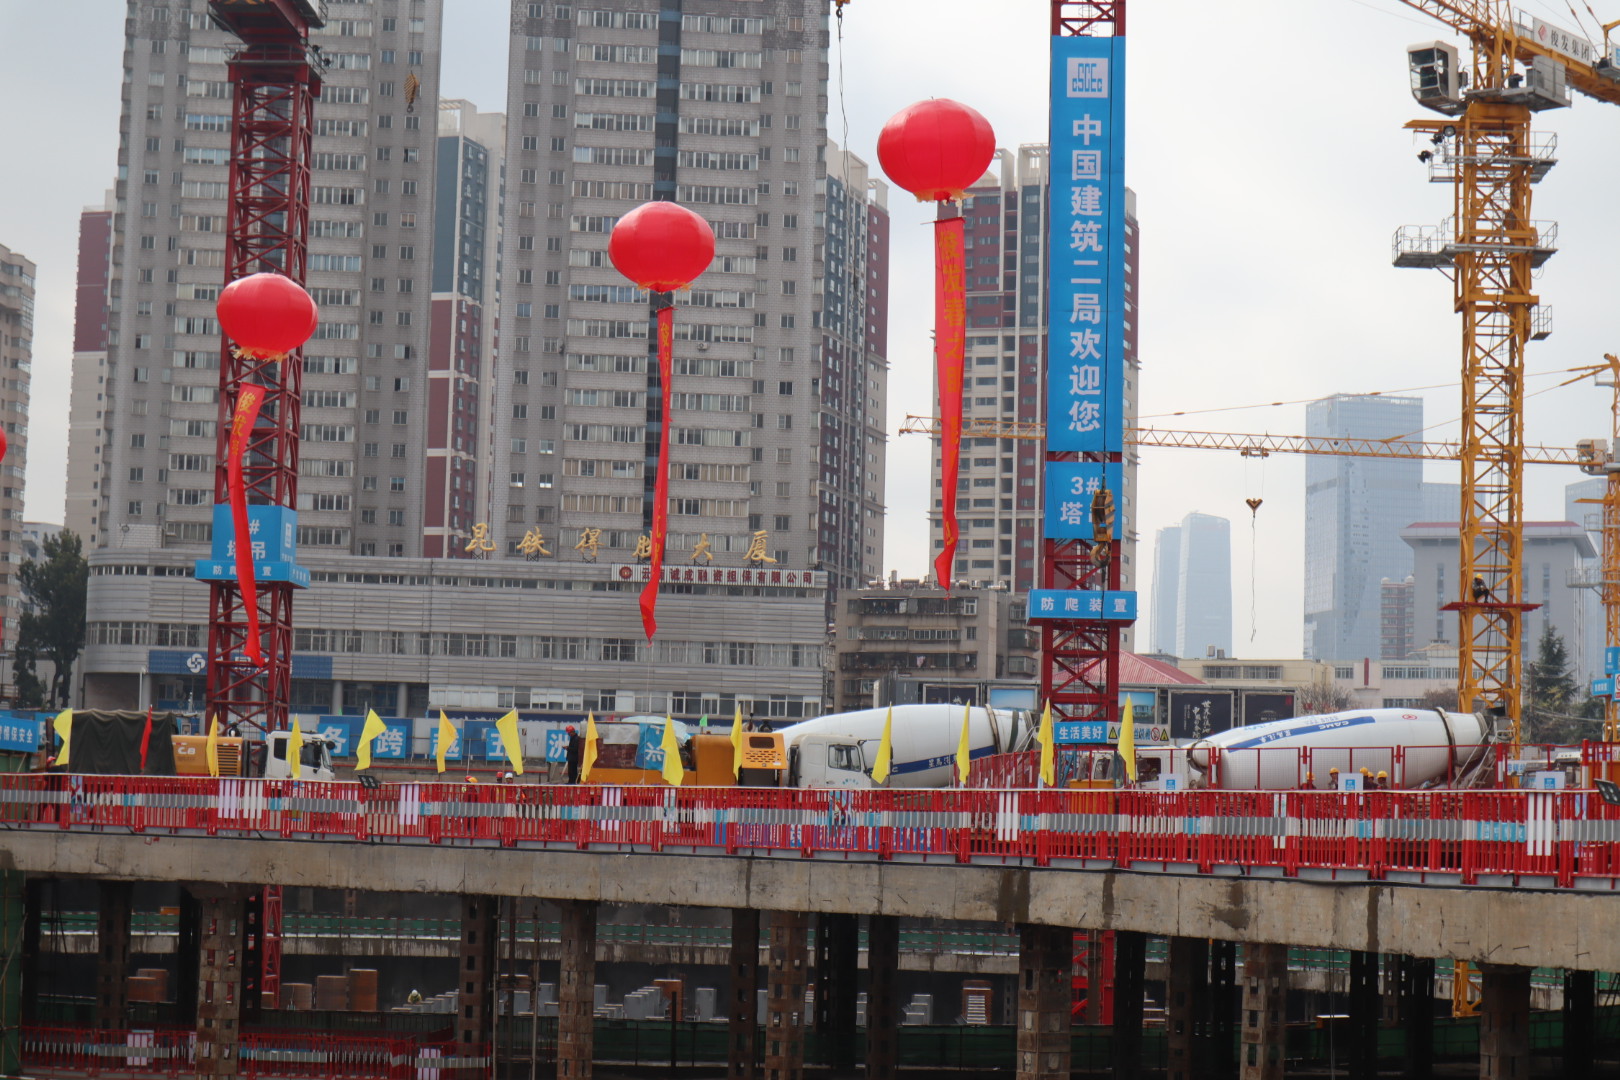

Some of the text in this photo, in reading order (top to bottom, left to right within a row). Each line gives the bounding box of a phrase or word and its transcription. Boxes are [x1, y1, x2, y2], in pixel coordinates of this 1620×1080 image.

[1069, 113, 1103, 432] 中国建筑二局欢迎您
[641, 567, 813, 584] 云诚成融资担保有限公司
[1041, 598, 1127, 613] 防爬装置
[1059, 726, 1104, 740] 生活美好
